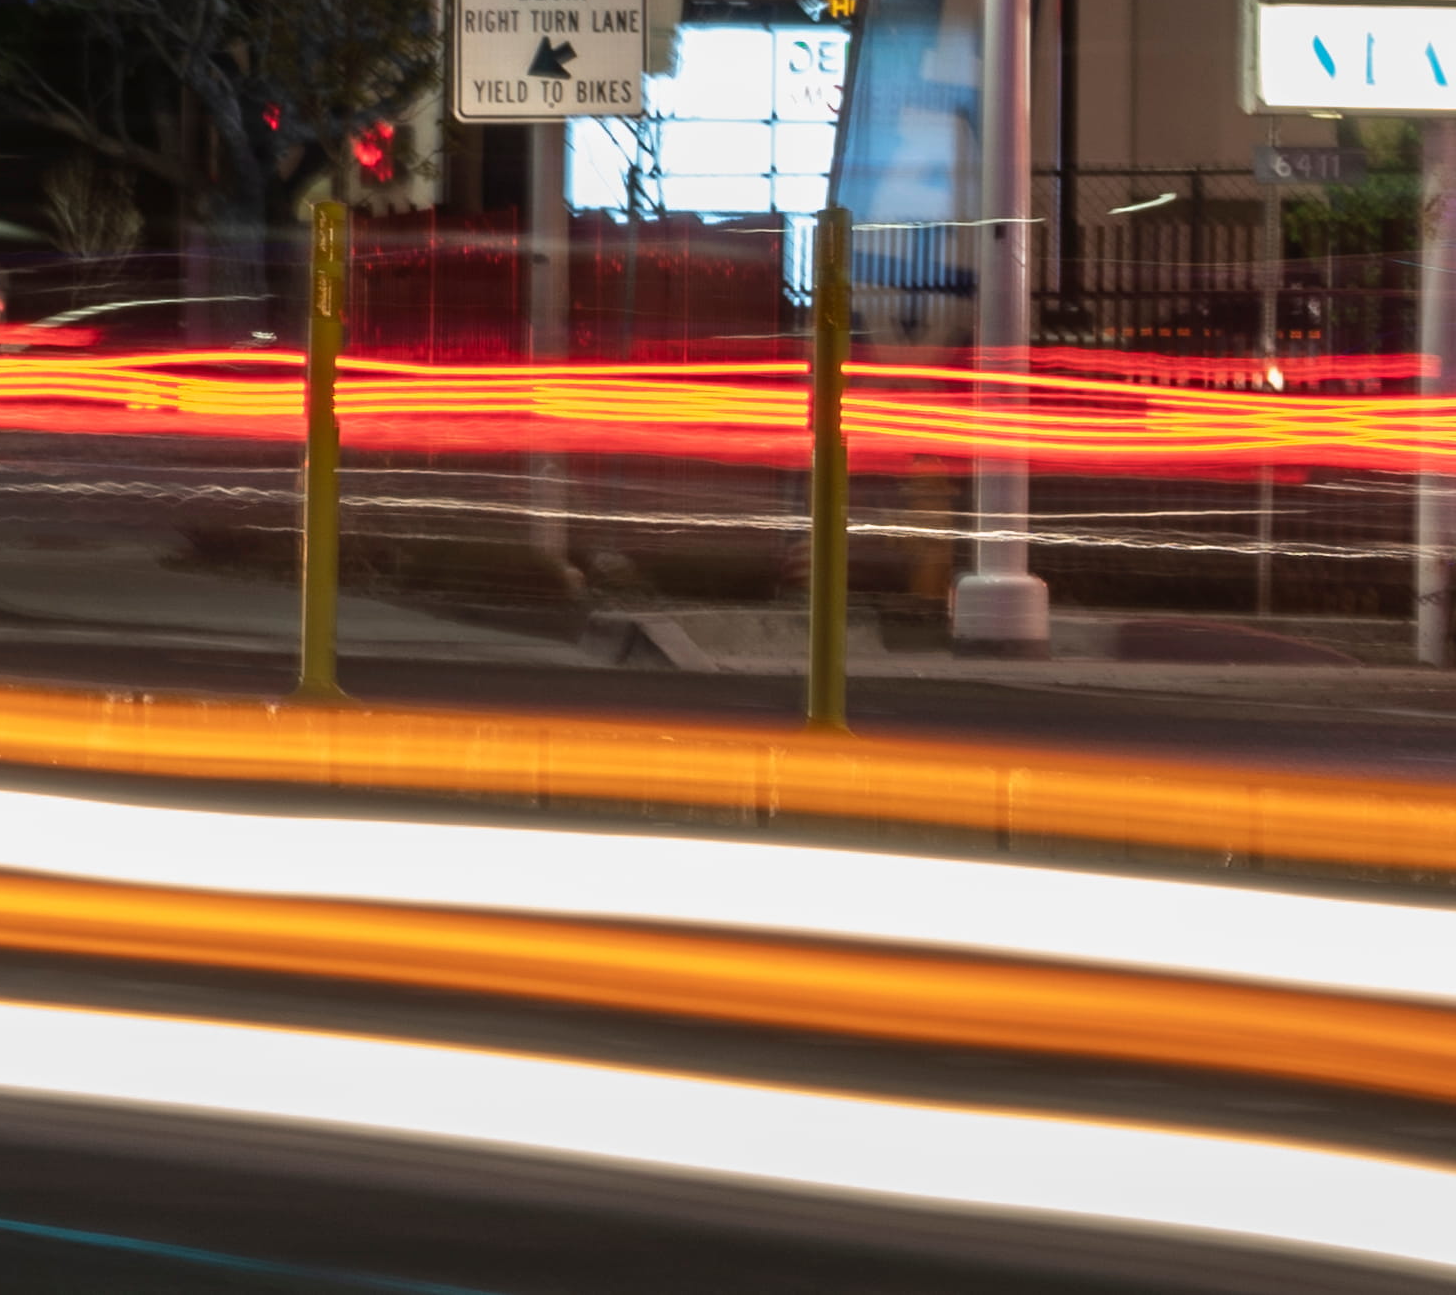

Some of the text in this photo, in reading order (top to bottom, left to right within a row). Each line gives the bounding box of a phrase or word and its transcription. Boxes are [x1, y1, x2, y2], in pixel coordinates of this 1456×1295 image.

[465, 9, 640, 34] RIGHT TURN LANE
[473, 80, 632, 104] YIELD TO BIKES
[1270, 155, 1342, 179] 6411
